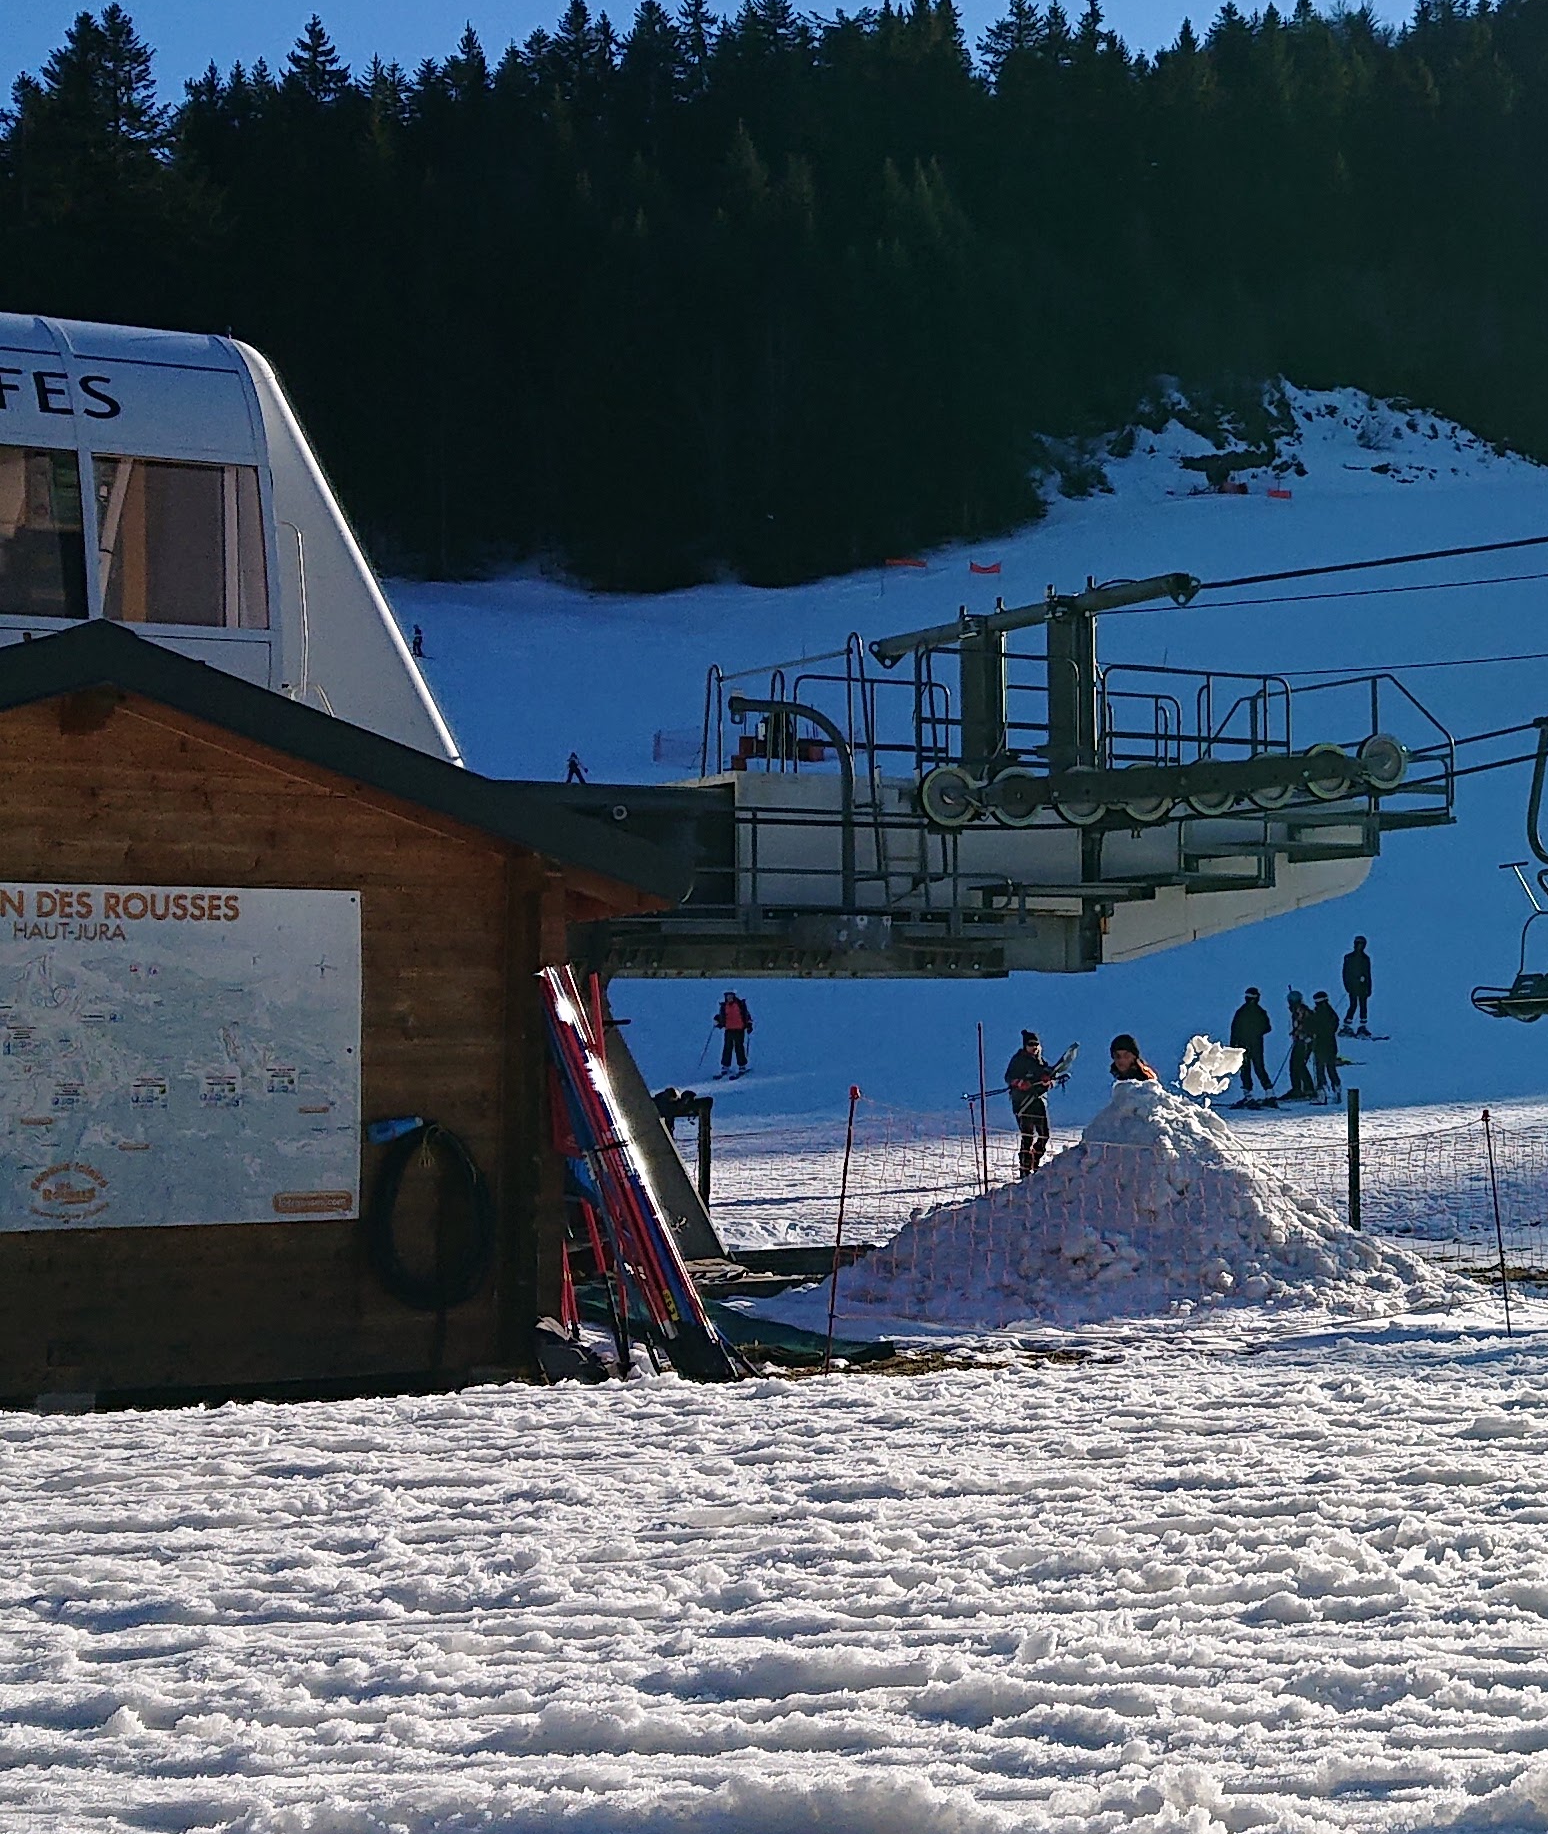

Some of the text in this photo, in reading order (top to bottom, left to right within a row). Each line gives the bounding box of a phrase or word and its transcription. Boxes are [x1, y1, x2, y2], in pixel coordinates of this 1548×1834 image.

[0, 367, 121, 419] FES
[36, 890, 93, 919] DES
[104, 892, 240, 922] ROUSSES
[13, 921, 126, 941] HAUT-JURA
